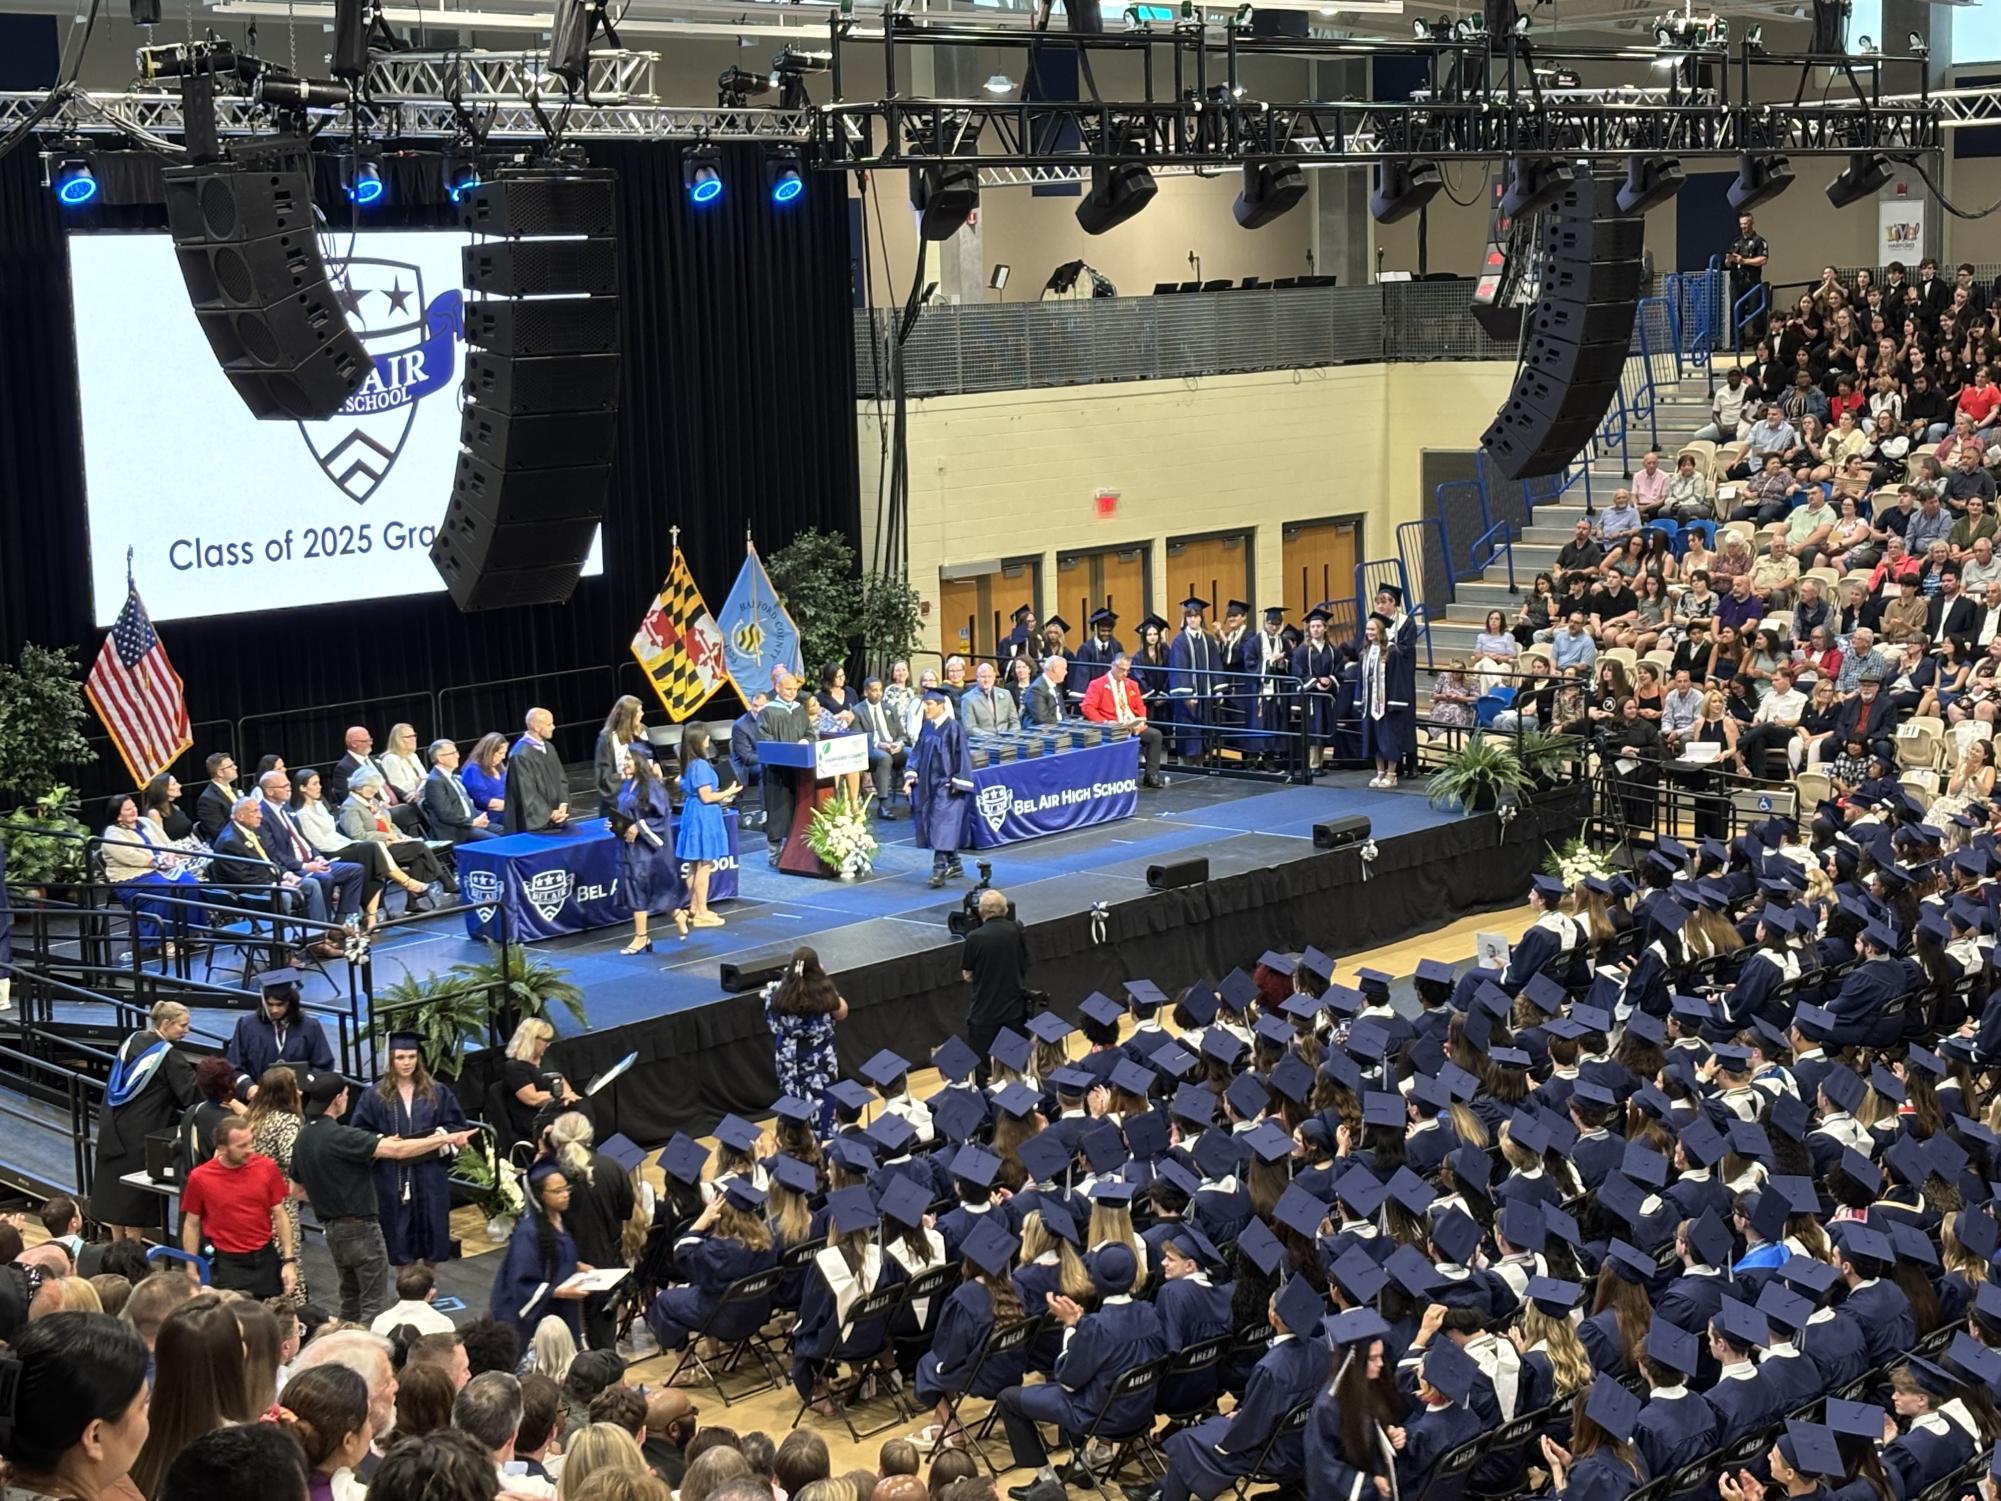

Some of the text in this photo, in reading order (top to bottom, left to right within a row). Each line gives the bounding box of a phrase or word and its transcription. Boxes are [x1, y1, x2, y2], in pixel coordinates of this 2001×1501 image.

[345, 386, 412, 412] SCHOOL
[169, 537, 254, 571] Class
[264, 529, 294, 562] of
[303, 523, 373, 558] 2025
[1014, 778, 1137, 816] BEL AIR HIGH SCHOOL
[577, 884, 608, 903] BEL
[743, 1278, 768, 1293] ARENA
[1000, 1329, 1026, 1348] ARENA
[1189, 1346, 1217, 1365] ARENA
[1128, 1370, 1152, 1388] ARENA
[1505, 1419, 1533, 1440] ARENA
[1451, 1445, 1477, 1467] ARENA
